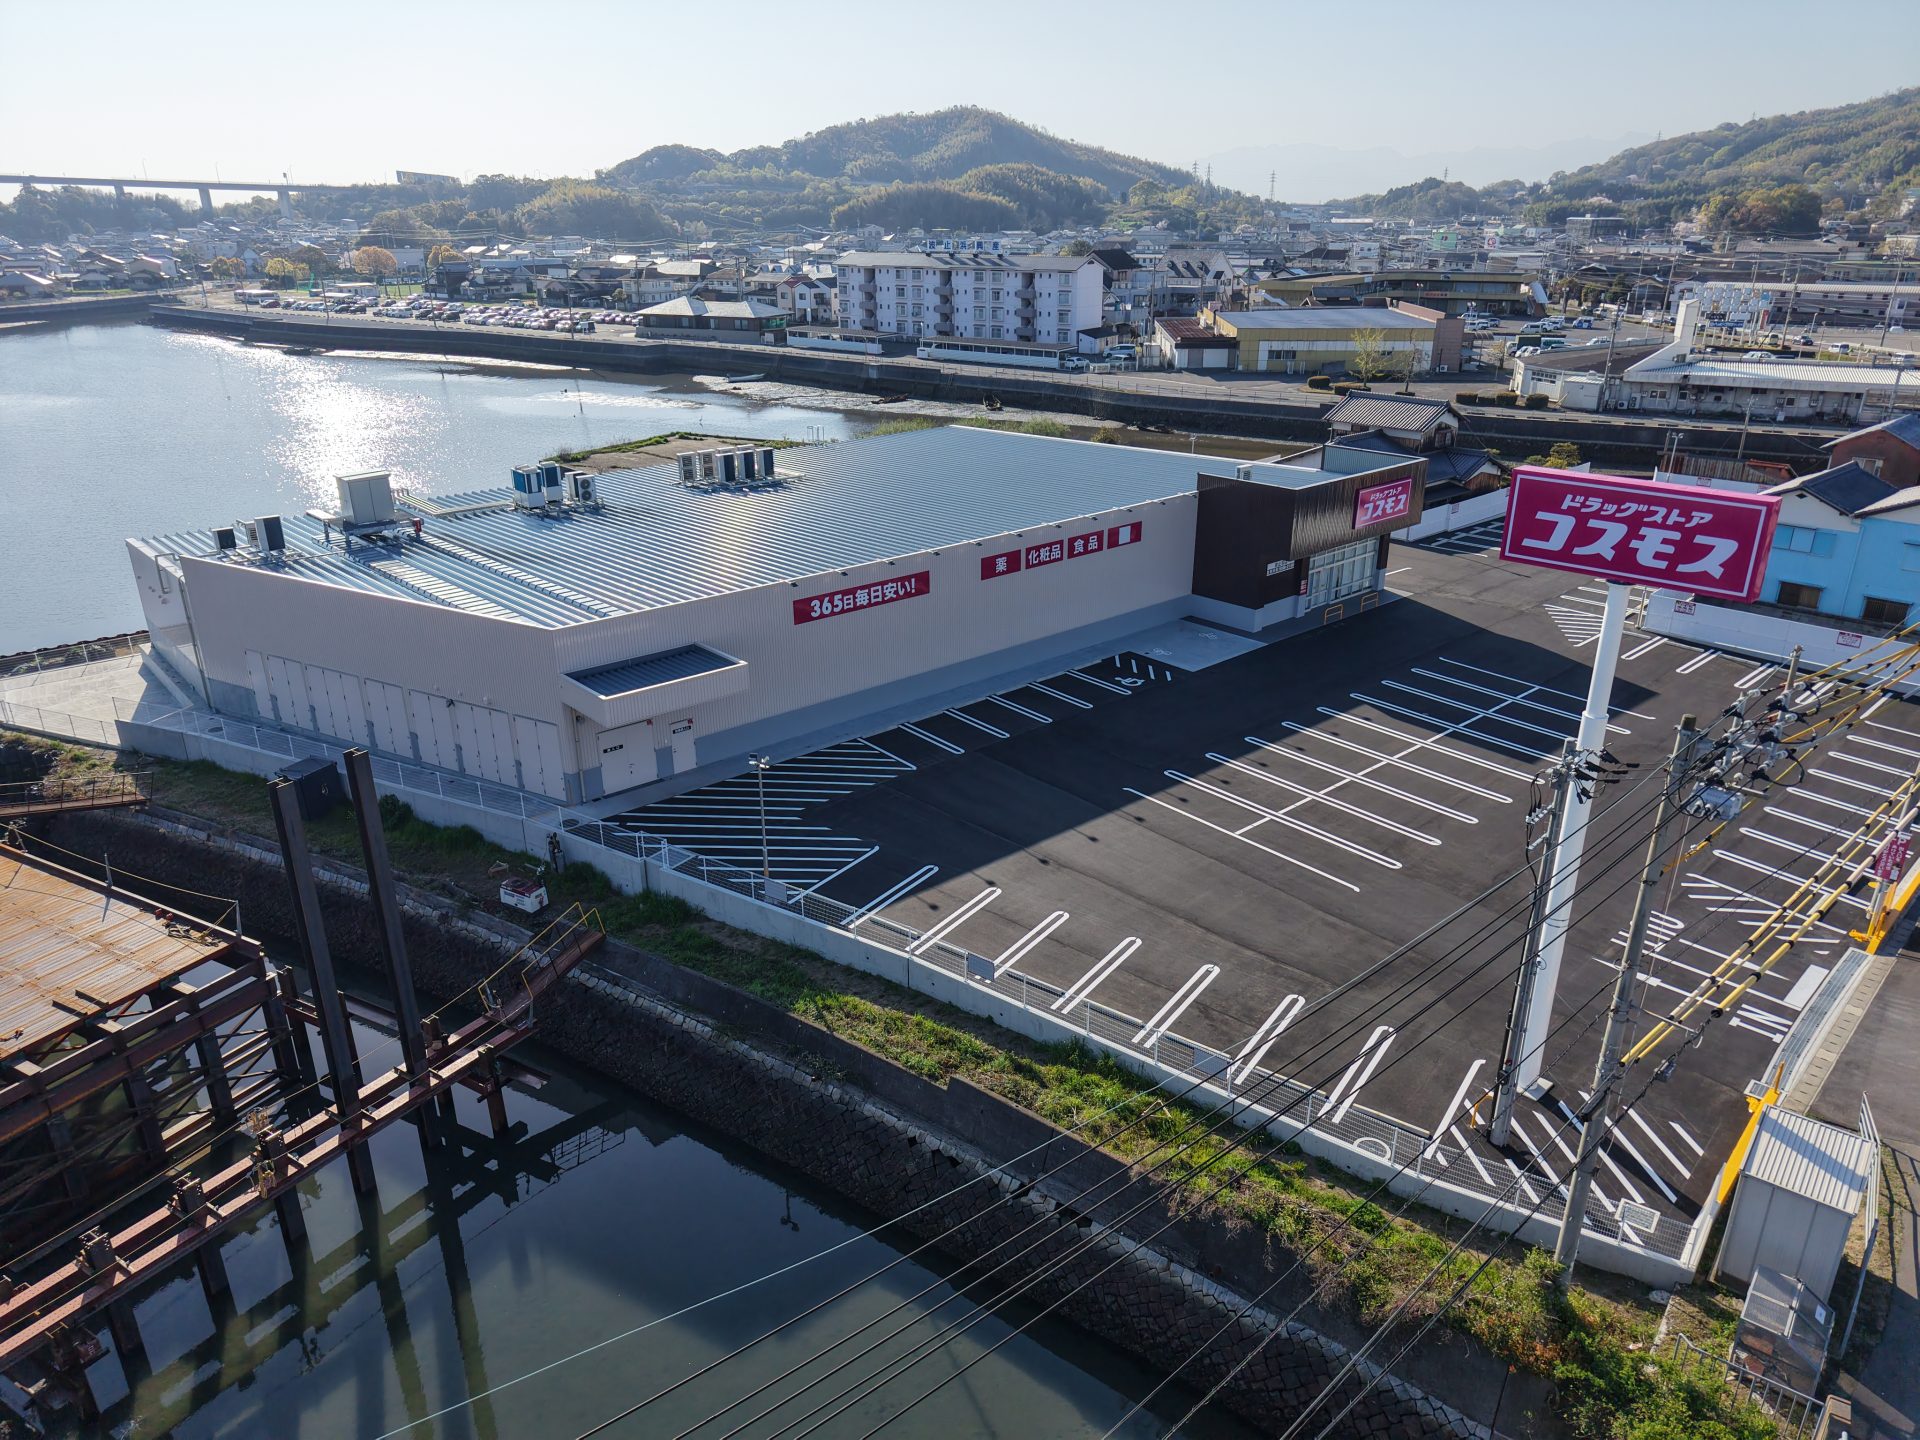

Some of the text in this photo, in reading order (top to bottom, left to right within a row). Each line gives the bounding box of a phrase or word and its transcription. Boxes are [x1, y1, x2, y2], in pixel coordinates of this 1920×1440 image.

[1360, 493, 1407, 522] コスモス
[1370, 486, 1402, 502] ドラッグストア
[1560, 494, 1713, 528] ドラッグストア
[995, 535, 1098, 574] 薬 化粧品 食品
[1521, 511, 1739, 579] コスモス
